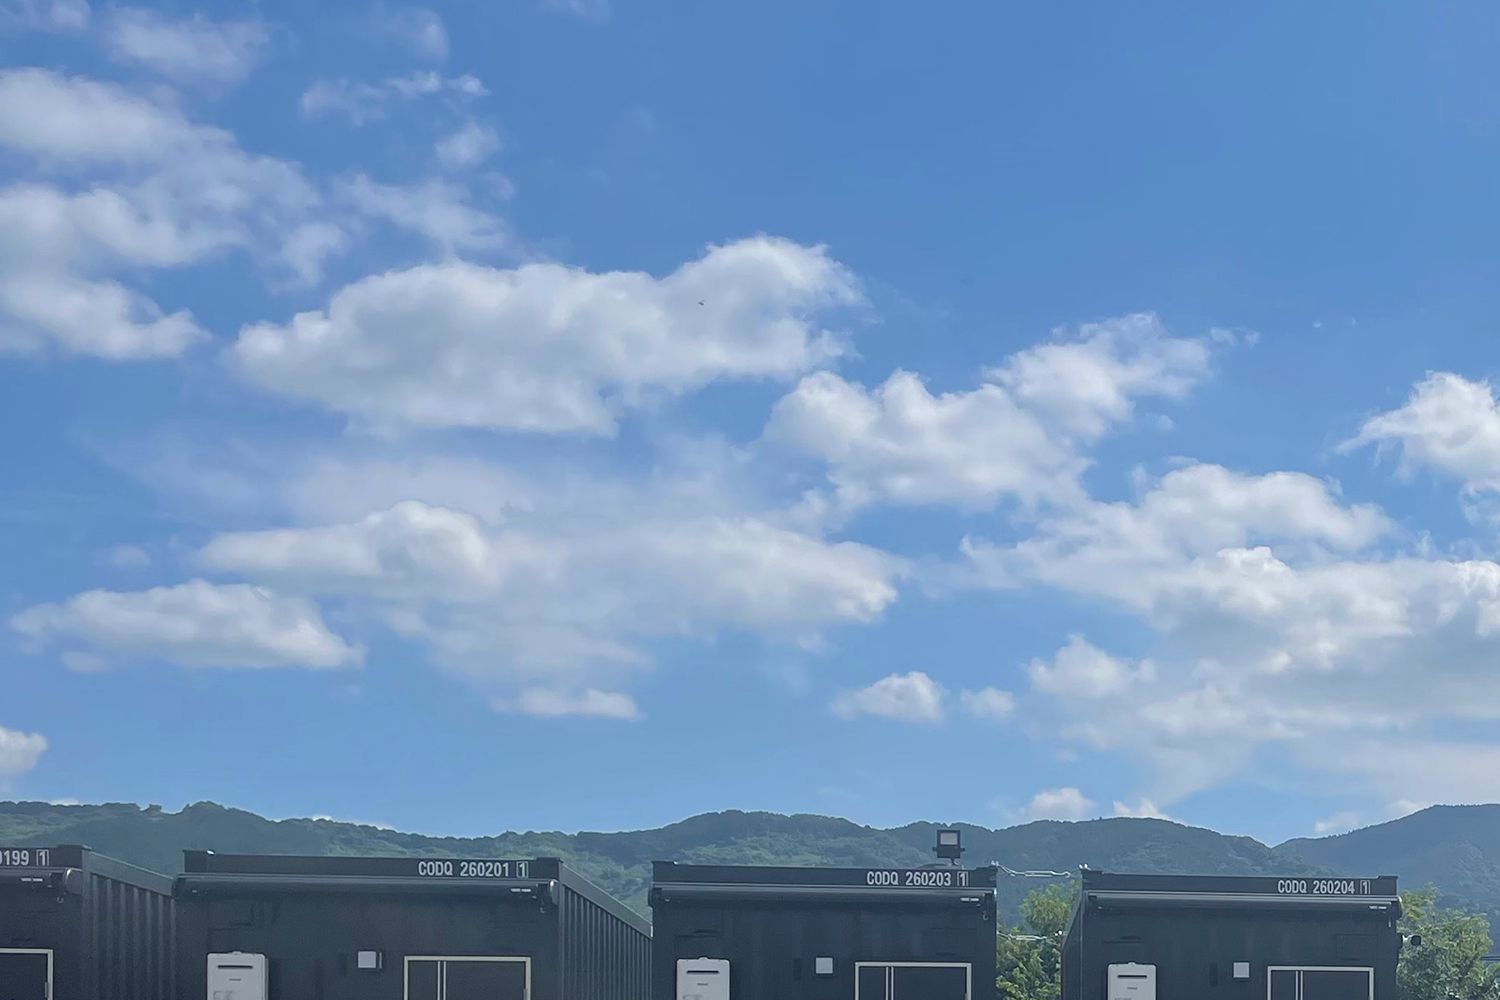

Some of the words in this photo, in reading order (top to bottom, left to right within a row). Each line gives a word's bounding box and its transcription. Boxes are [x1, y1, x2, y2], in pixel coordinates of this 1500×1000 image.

[0, 850, 30, 866] 199
[418, 861, 453, 876] CODQ
[460, 862, 509, 877] 260201
[867, 871, 899, 885] CODQ
[905, 872, 951, 886] 260203
[1278, 880, 1307, 893] CODQ
[1313, 880, 1355, 894] 260204
